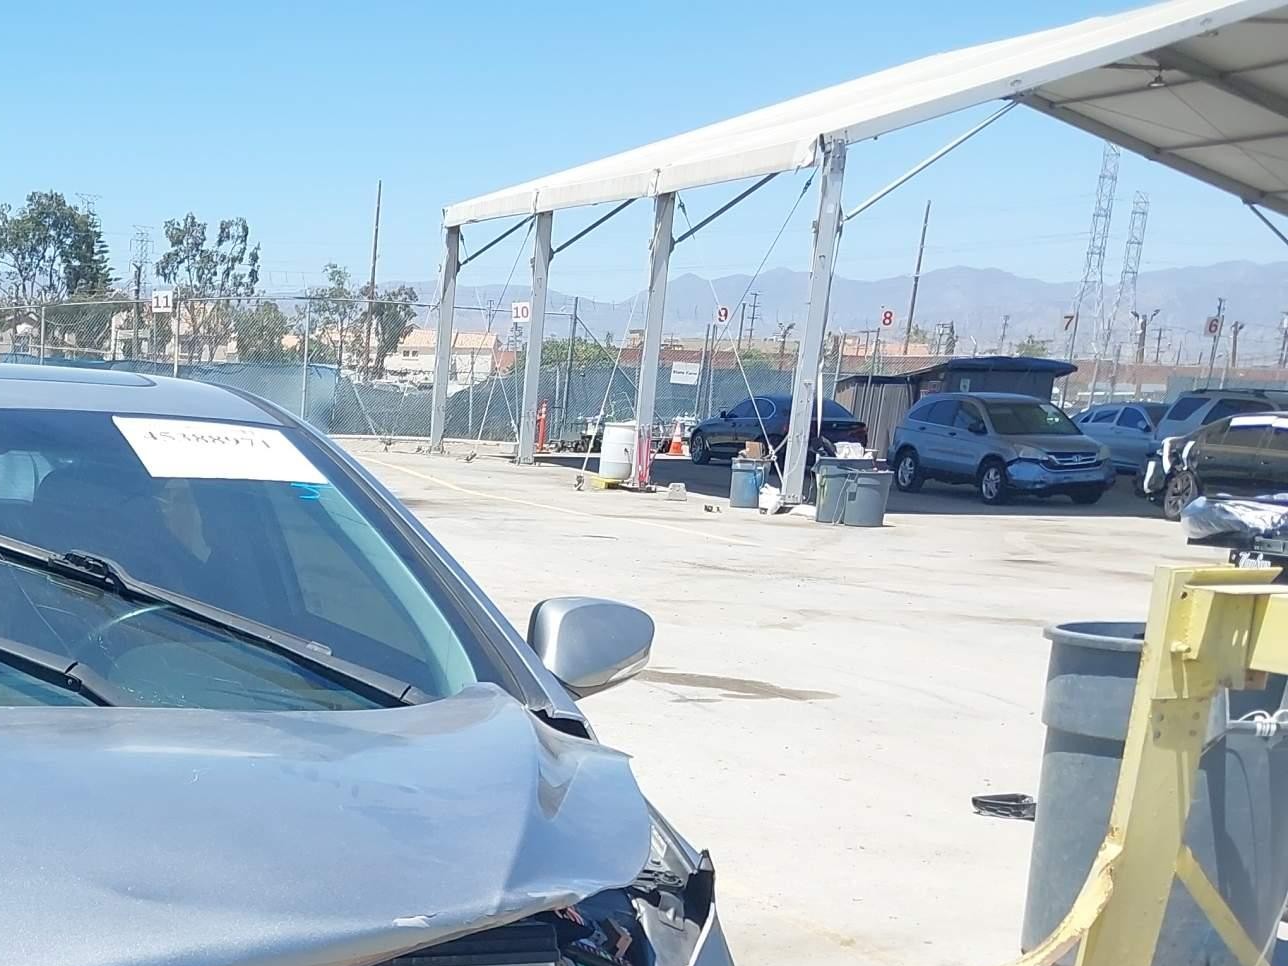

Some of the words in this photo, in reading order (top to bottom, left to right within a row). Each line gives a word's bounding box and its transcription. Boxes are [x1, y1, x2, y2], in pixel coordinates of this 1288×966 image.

[153, 295, 171, 309] 11
[513, 306, 529, 319] 10
[718, 307, 729, 322] 9
[882, 310, 893, 326] 8
[1064, 315, 1074, 331] 7
[1208, 318, 1219, 334] 6
